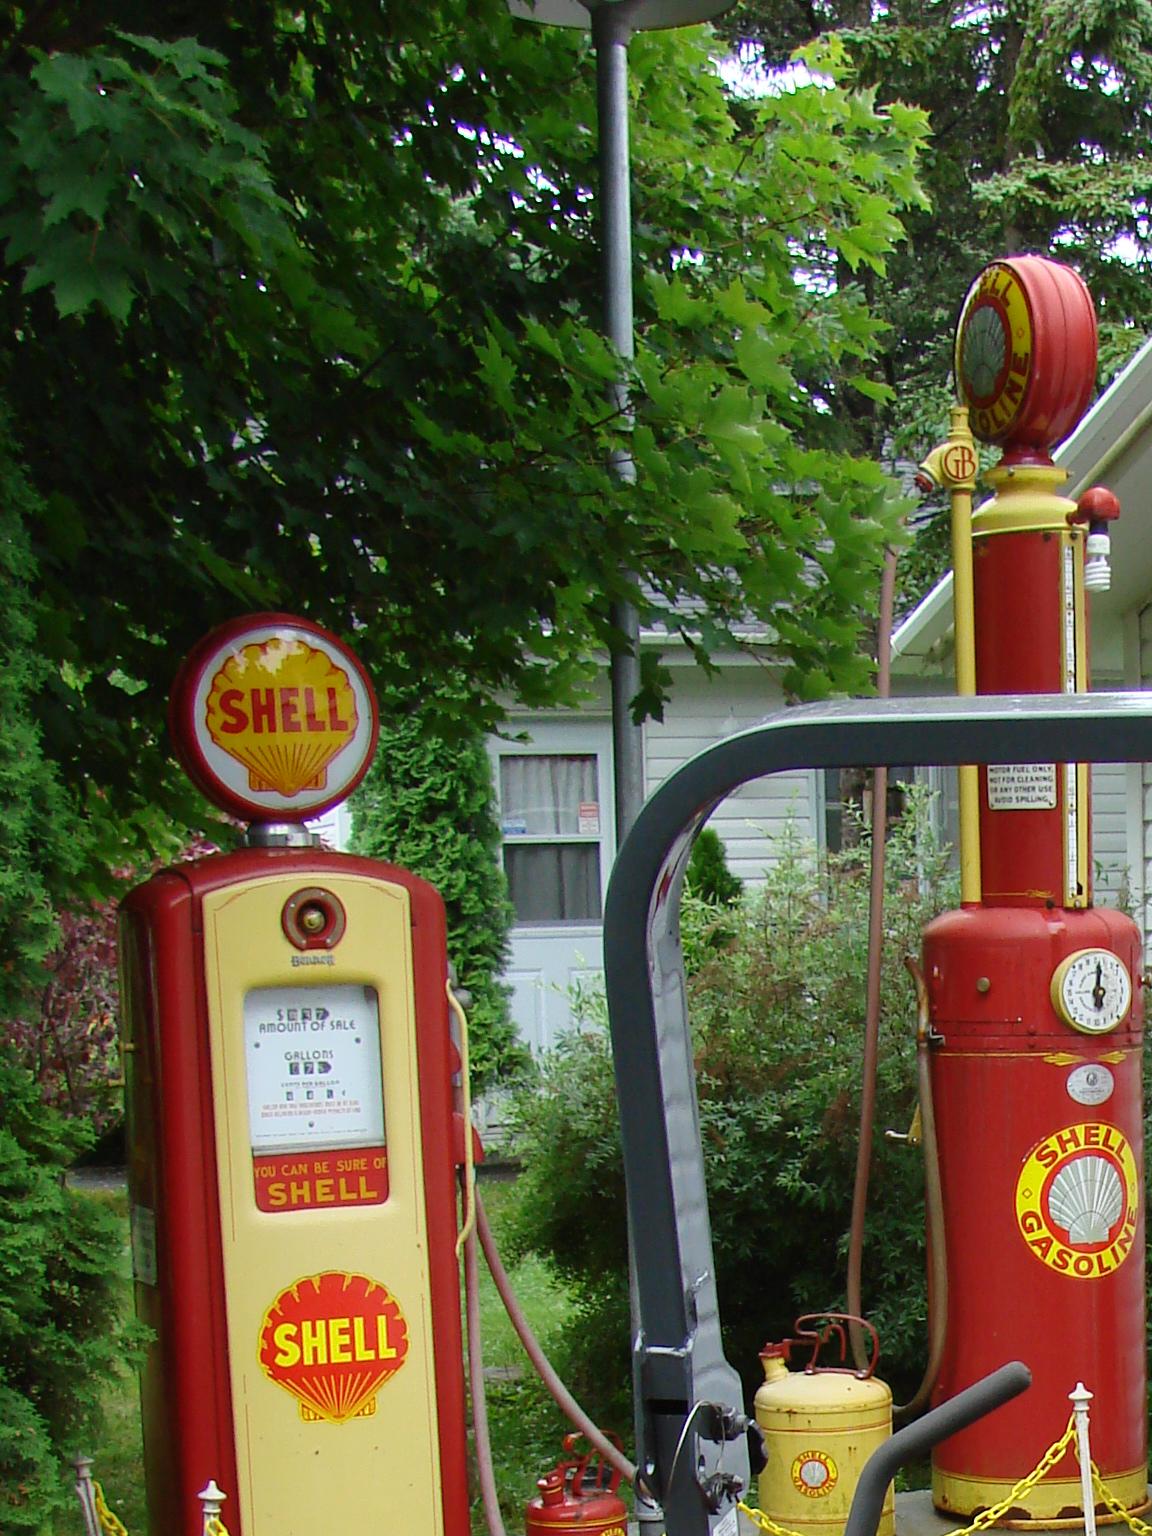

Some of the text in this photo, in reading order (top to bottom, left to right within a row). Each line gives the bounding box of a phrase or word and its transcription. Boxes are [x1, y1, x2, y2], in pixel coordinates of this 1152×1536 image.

[219, 686, 349, 734] SHELL
[1016, 775, 1053, 783] CLEANING
[259, 1019, 357, 1033] AMOUNT OF SALE
[284, 1050, 334, 1061] GALLONS
[1035, 1125, 1129, 1169] SHELL
[254, 1165, 276, 1178] YOU
[281, 1163, 308, 1176] CAN
[314, 1161, 330, 1174] BE
[336, 1157, 368, 1172] SURE
[267, 1175, 378, 1206] SHELL
[1021, 1206, 1137, 1277] GASOLINE
[273, 1314, 397, 1368] SHELL
[797, 1450, 830, 1464] SHELL
[792, 1476, 838, 1498] GASOLINE
